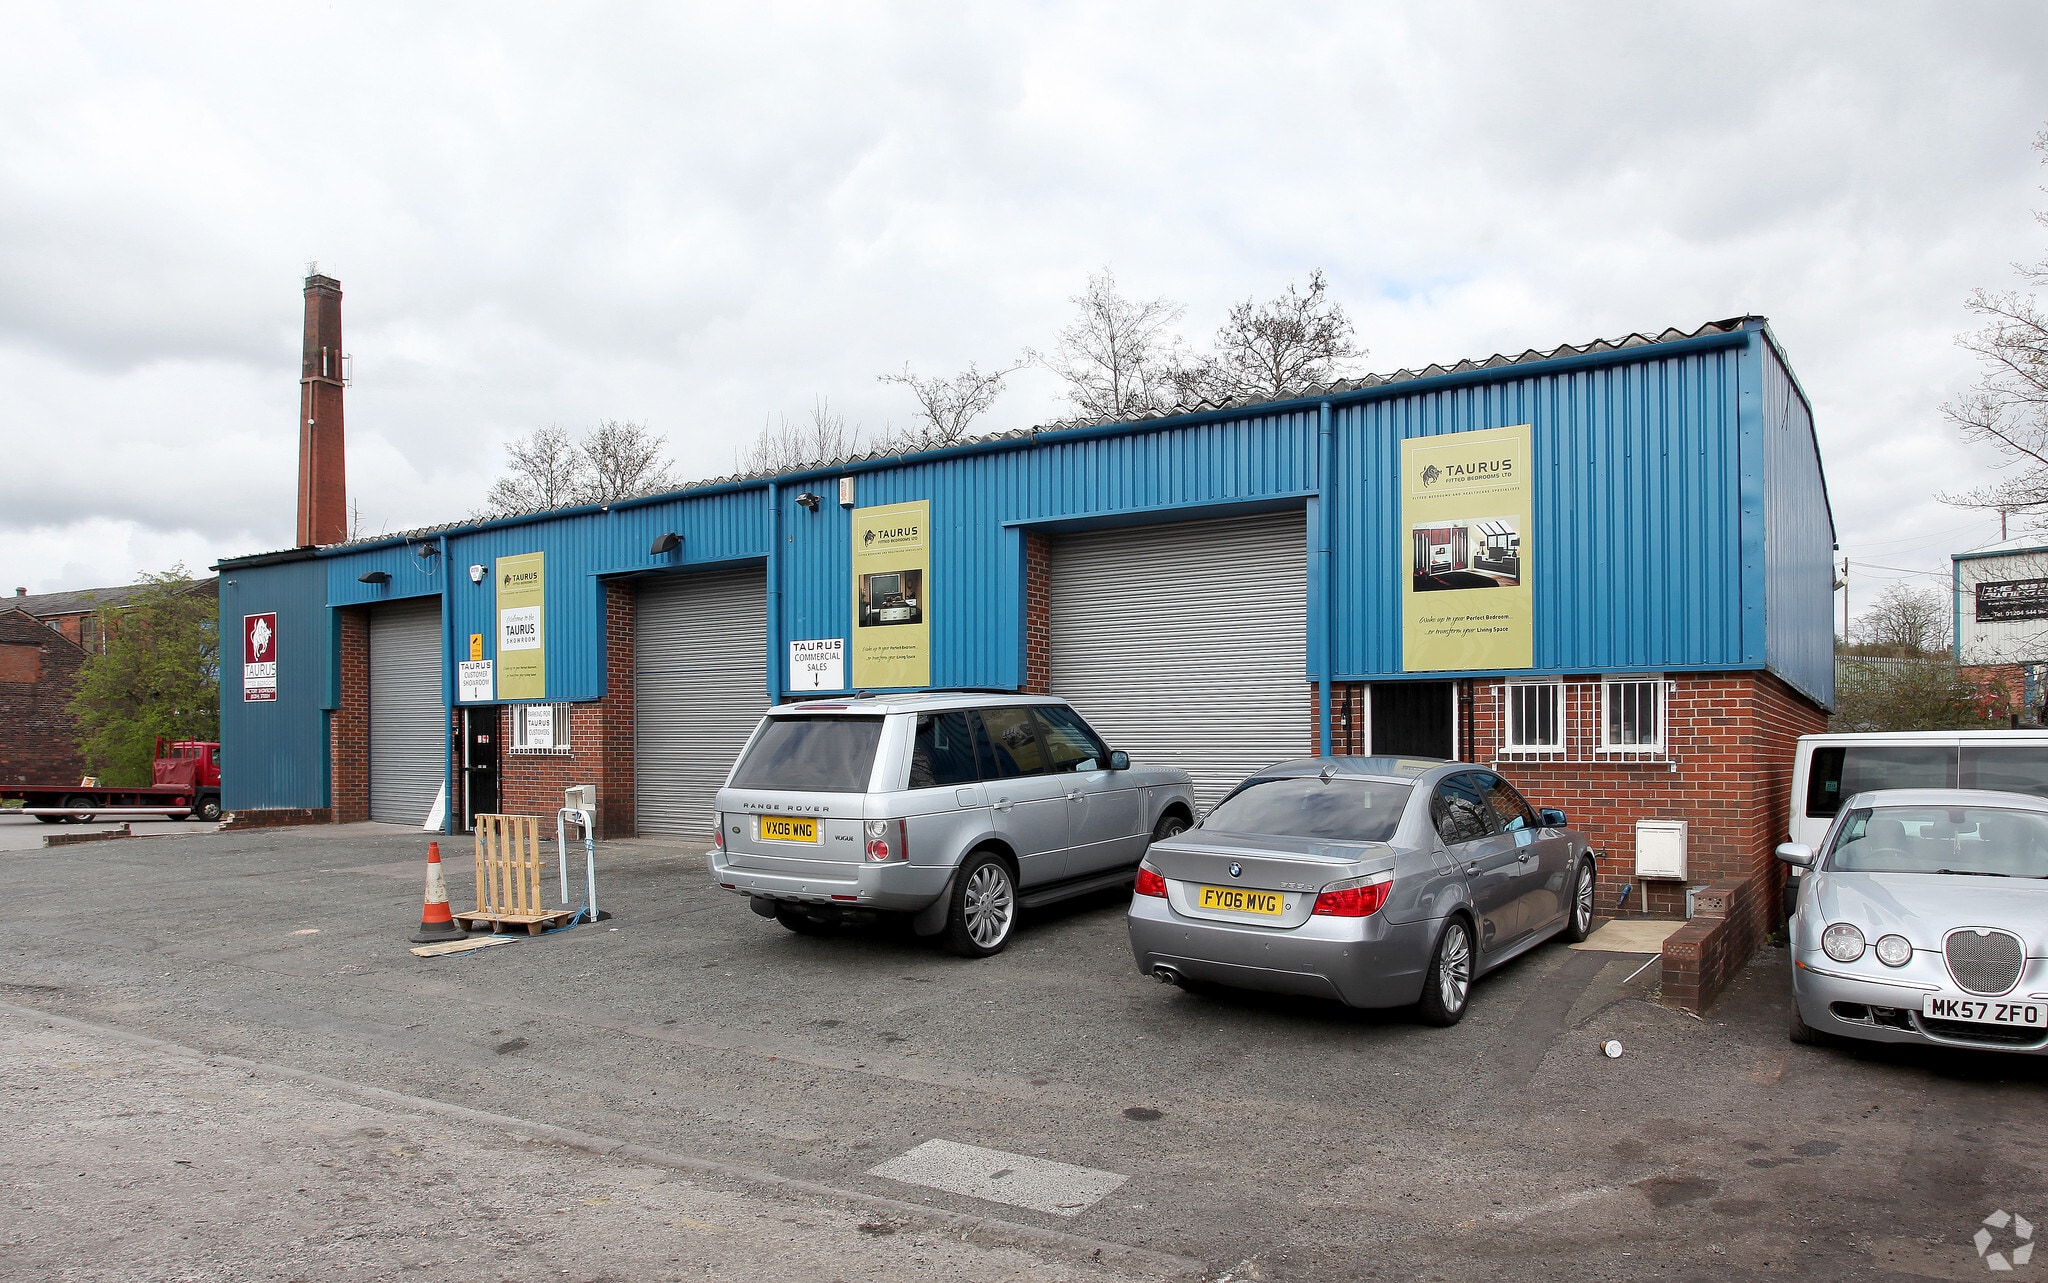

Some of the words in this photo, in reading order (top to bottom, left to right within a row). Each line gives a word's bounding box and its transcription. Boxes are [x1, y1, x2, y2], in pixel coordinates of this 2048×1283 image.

[1446, 459, 1512, 476] TAURUS
[1467, 473, 1500, 481] BEDROOMS
[878, 526, 918, 538] TAURUS
[512, 572, 538, 581] TAURUS
[506, 624, 535, 636] TAURUS
[1462, 628, 1476, 638] your
[506, 636, 536, 644] SHOWROOM
[793, 641, 841, 651] TAURUS
[794, 652, 841, 661] COMMERCIAL
[245, 663, 276, 676] TAURUS
[460, 662, 491, 670] TAURUS
[807, 663, 828, 671] SALES
[464, 670, 488, 679] CUSTOMER
[766, 821, 791, 835] VX06
[792, 823, 812, 837] WNG
[1205, 889, 1243, 908] FY06
[1246, 894, 1276, 912] MVG
[1932, 998, 1988, 1019] MK57
[1994, 1004, 2037, 1023] ZFO
